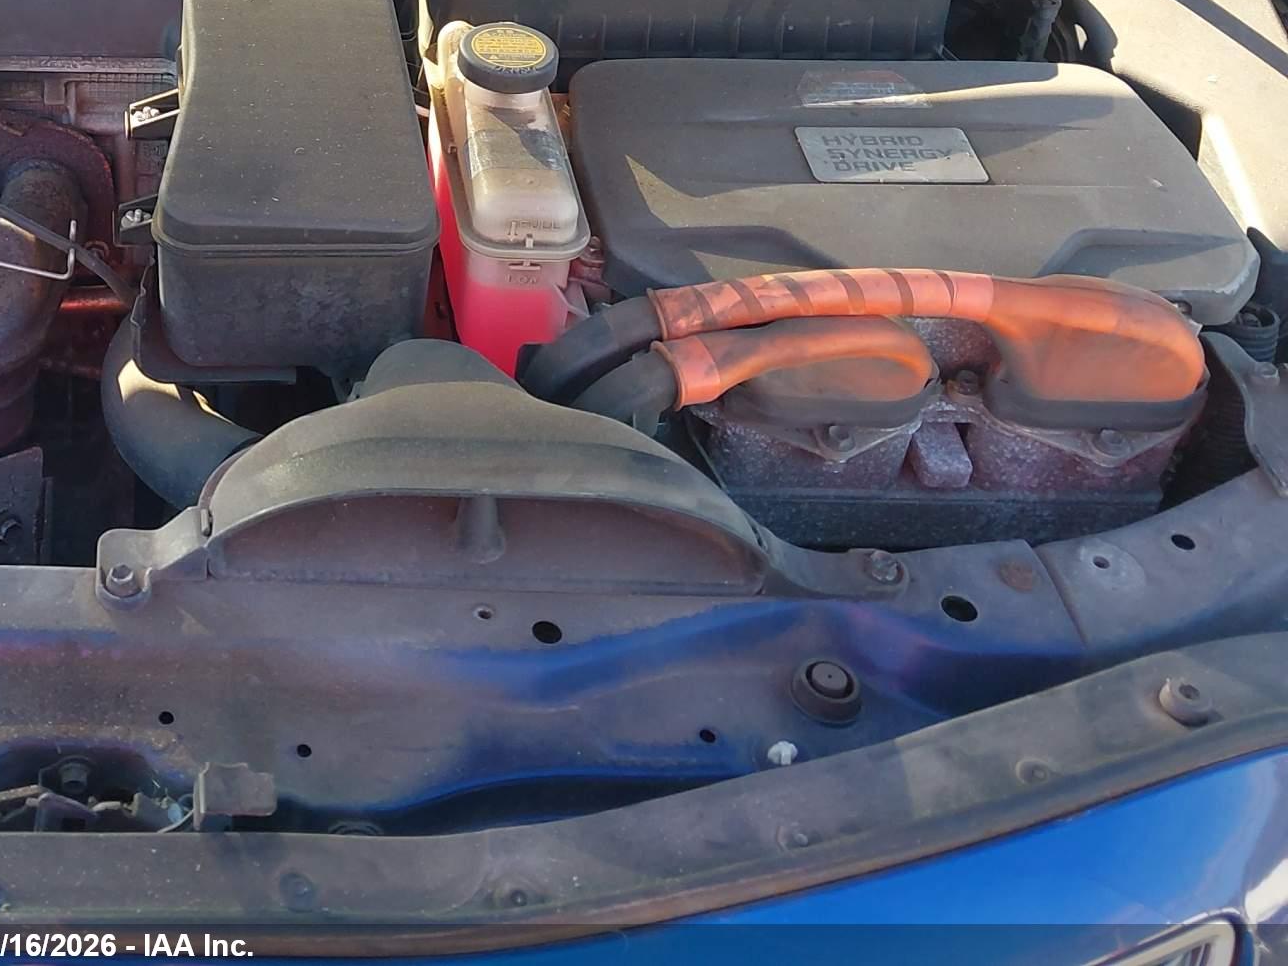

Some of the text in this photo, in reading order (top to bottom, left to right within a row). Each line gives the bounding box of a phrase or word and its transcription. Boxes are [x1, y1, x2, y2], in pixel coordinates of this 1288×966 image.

[821, 134, 924, 147] HYBRID
[826, 147, 953, 160] SYNERGY
[833, 160, 916, 172] DRIVE
